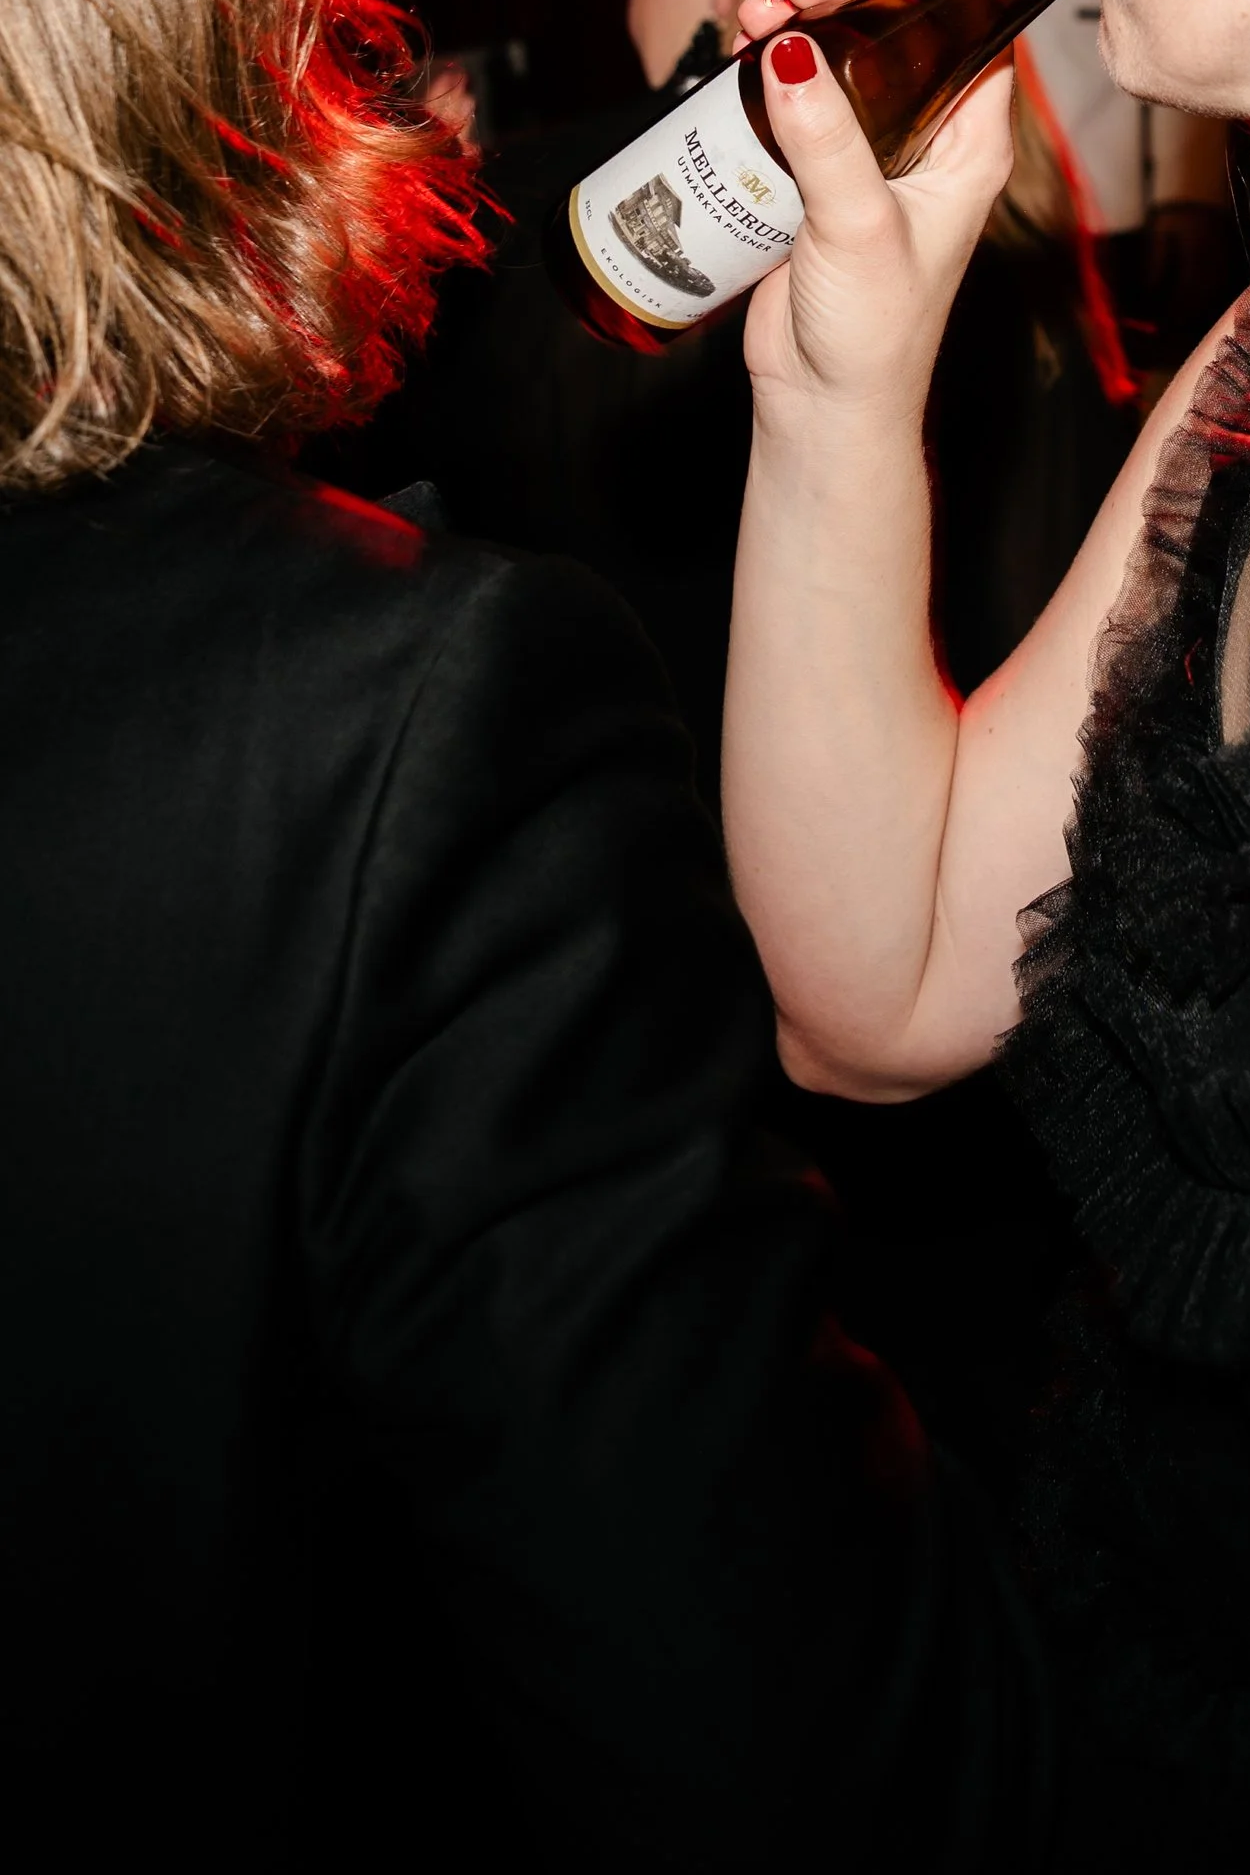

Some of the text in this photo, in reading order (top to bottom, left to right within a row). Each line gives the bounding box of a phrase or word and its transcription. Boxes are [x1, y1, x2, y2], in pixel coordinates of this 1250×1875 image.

[678, 156, 772, 252] UTMÄRKTA PILSNER
[601, 248, 662, 309] EKOLOGISK
